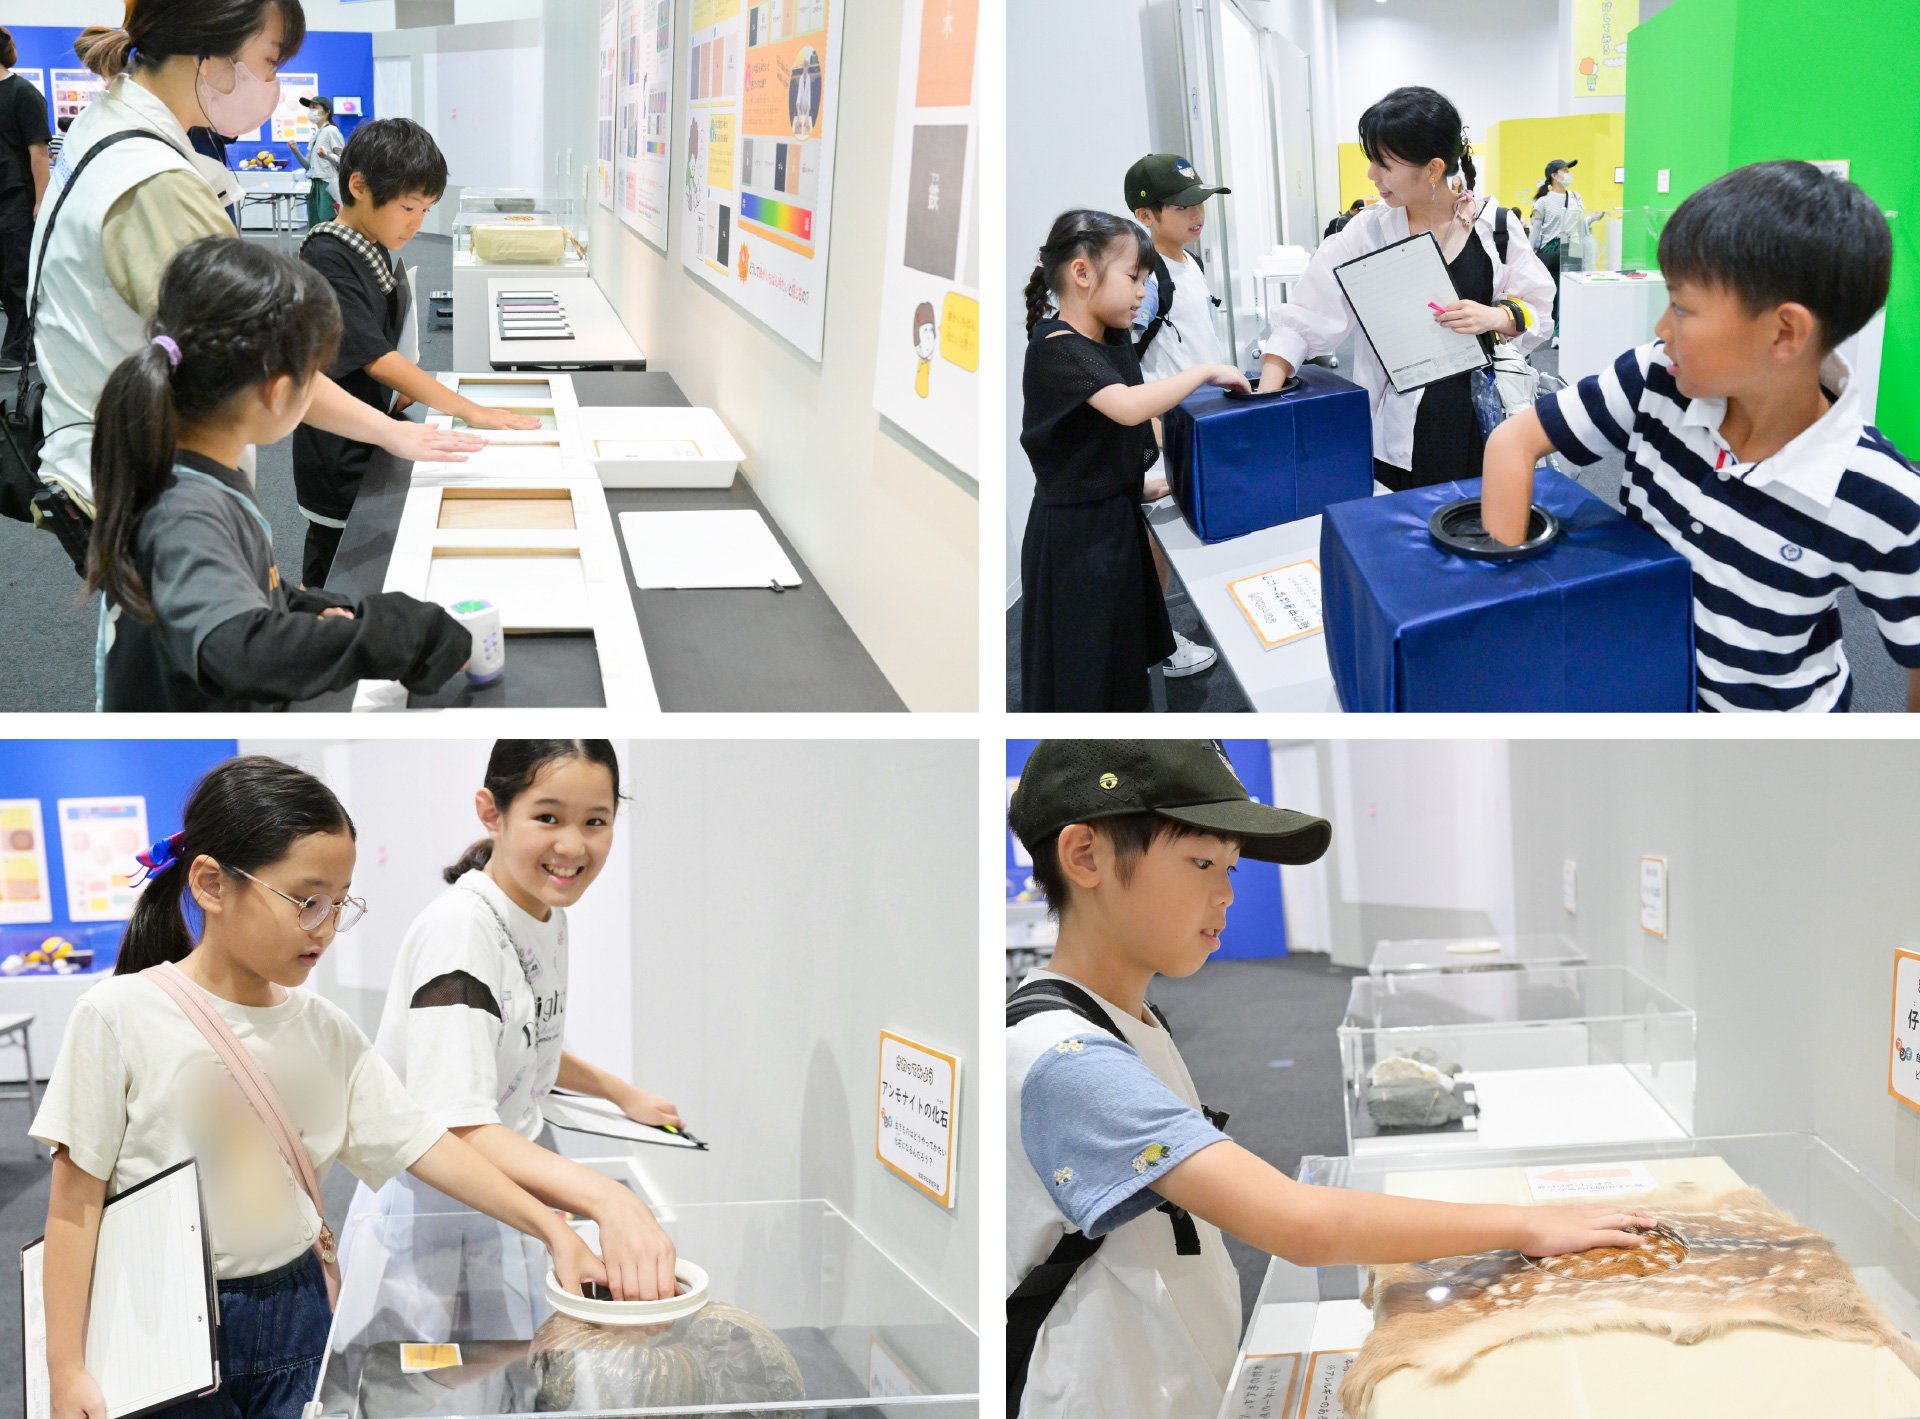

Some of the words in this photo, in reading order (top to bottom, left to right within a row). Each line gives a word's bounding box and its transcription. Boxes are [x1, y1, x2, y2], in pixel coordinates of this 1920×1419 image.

[882, 1081, 949, 1129] アンモナイトの化石
